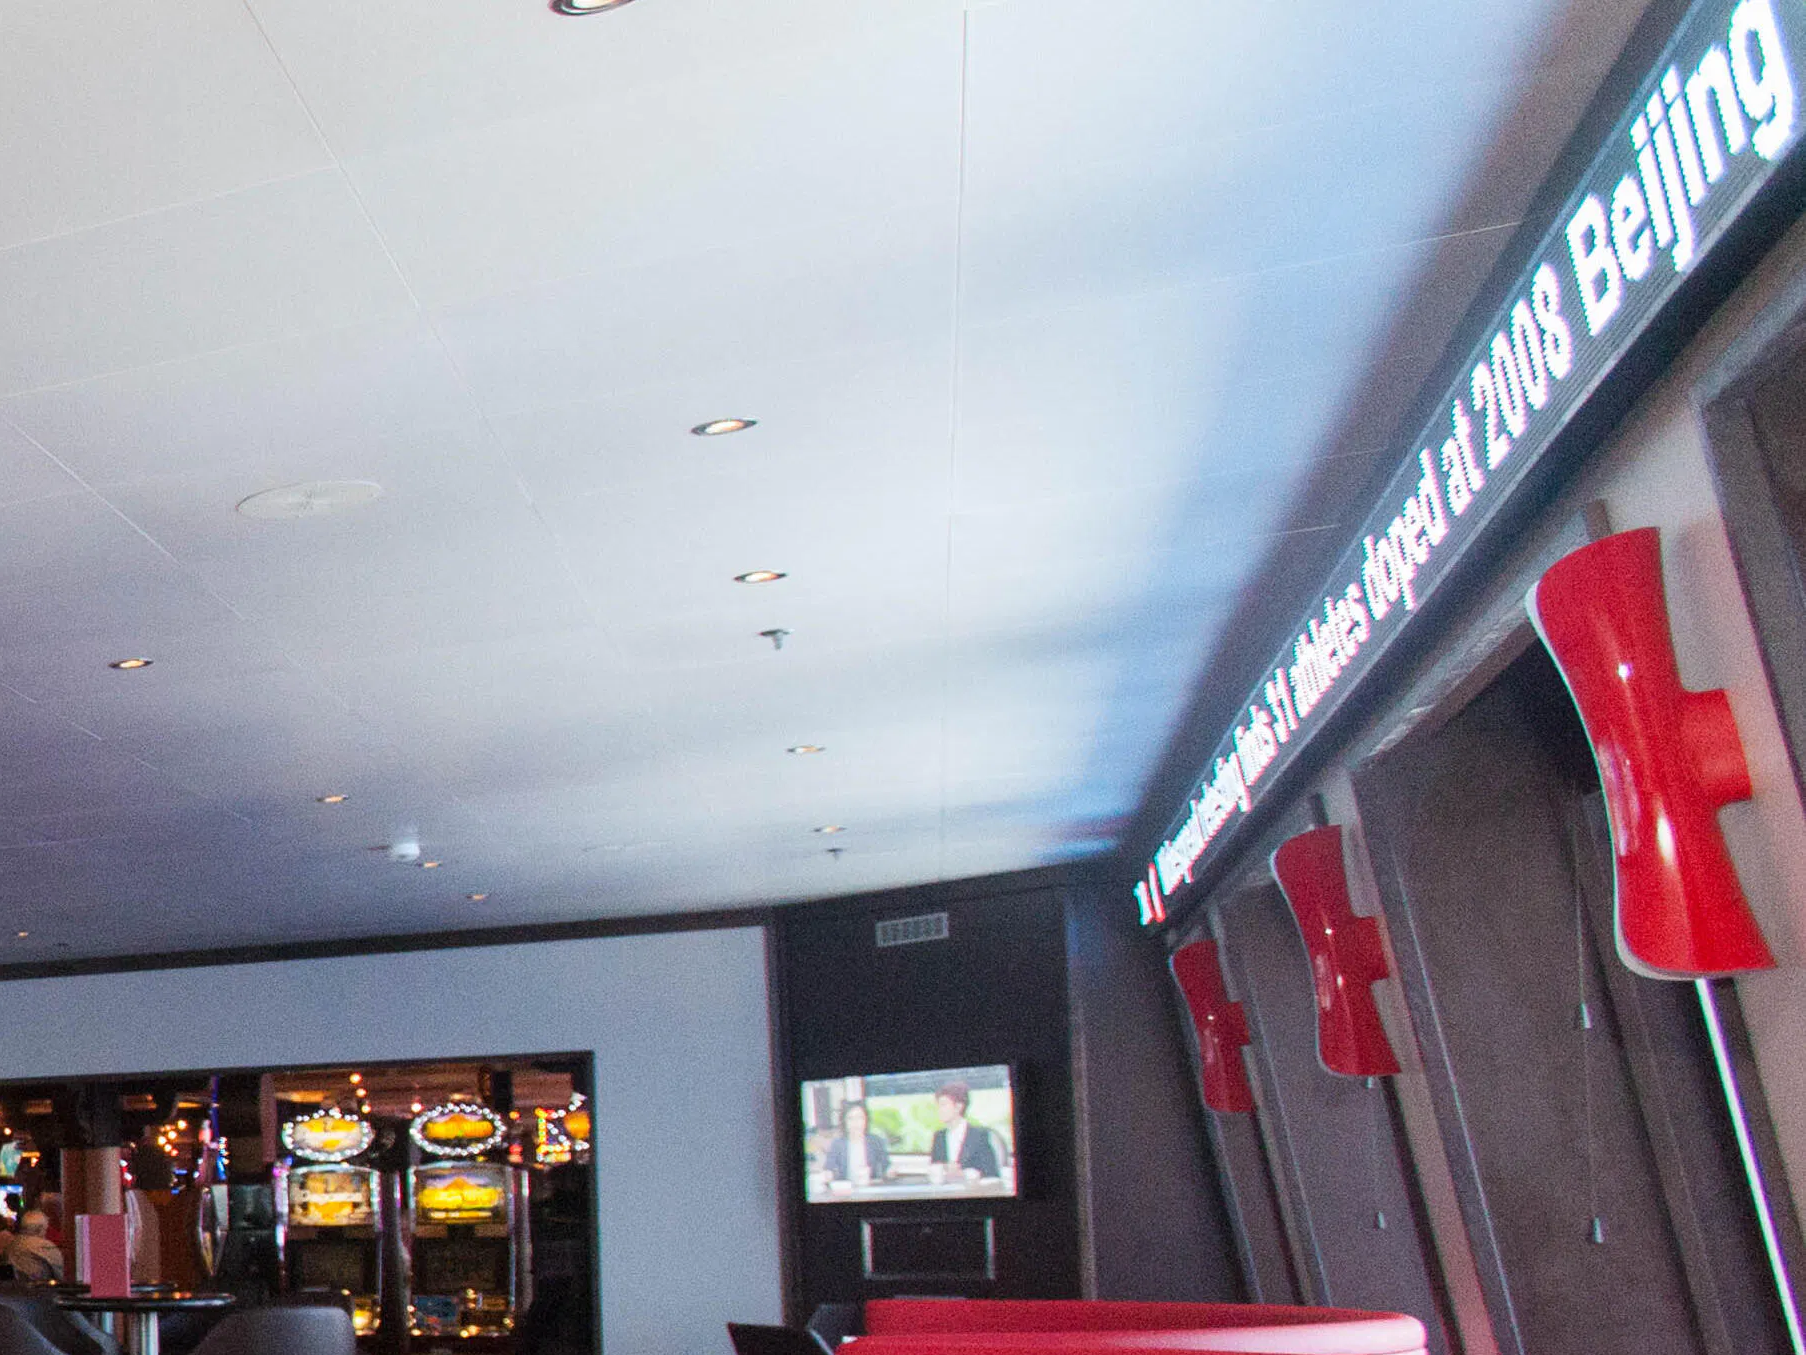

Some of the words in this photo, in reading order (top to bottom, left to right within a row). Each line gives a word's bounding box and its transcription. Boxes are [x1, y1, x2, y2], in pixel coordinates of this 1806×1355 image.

[1289, 583, 1370, 718] athletes
[1362, 448, 1449, 621] doped
[1440, 399, 1485, 516] at
[1470, 262, 1573, 470] 2008
[1565, 0, 1795, 337] Beijing
